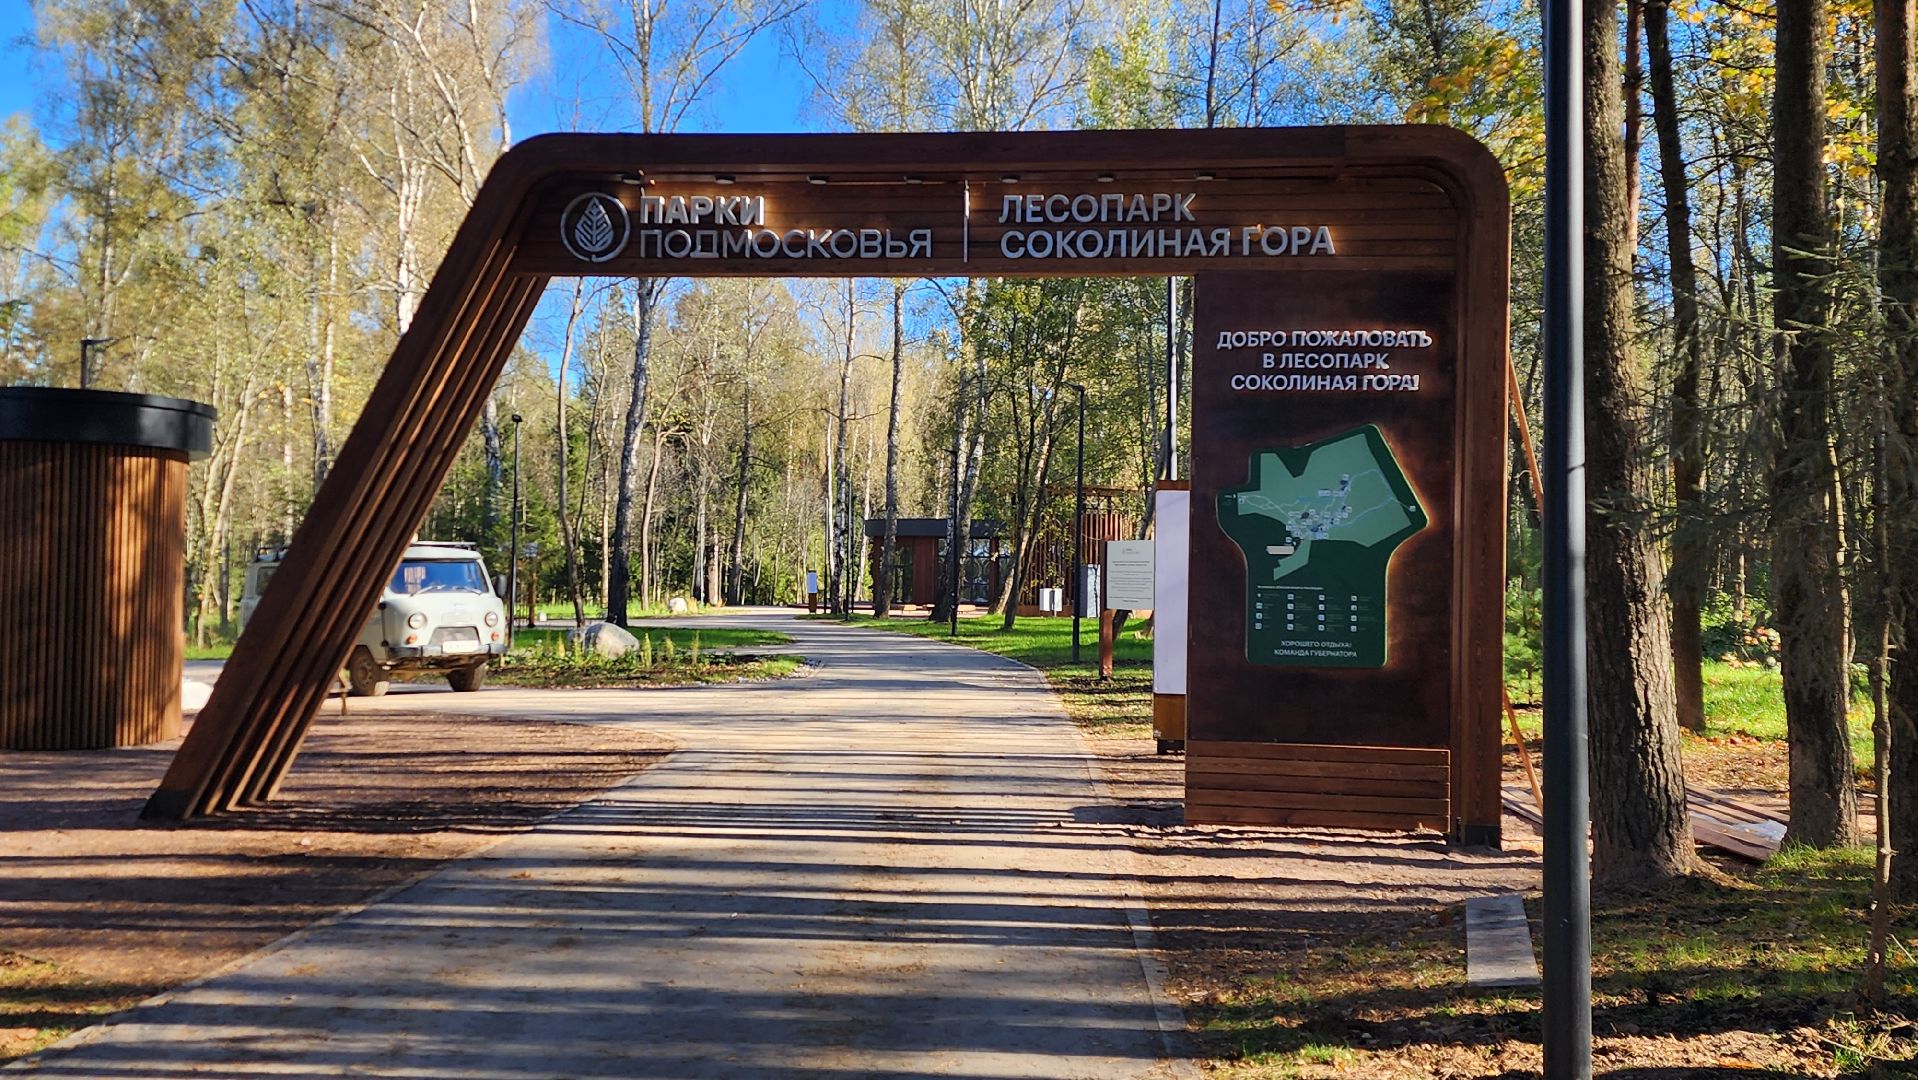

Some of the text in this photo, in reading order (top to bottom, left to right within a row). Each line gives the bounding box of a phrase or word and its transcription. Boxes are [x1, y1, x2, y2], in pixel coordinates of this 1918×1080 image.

[639, 195, 766, 226] ПАРКИ
[998, 192, 1197, 224] ЛЕСОПАРК
[639, 228, 933, 259] ПОДМОСКОВЬЯ
[1000, 224, 1336, 259] СОКОЛИНАЯ ГОРА
[1216, 329, 1433, 350] ДОБРО ПОЖАЛОВАТЬ
[1262, 352, 1390, 370] В ЛЕСОПАРК
[1230, 374, 1420, 391] СОКОЛИНАЯ ГОРА!
[1273, 649, 1358, 658] КОМАНДА ГУБЕРНАТОРА
[1280, 640, 1320, 648] ХОРОШЕГО
